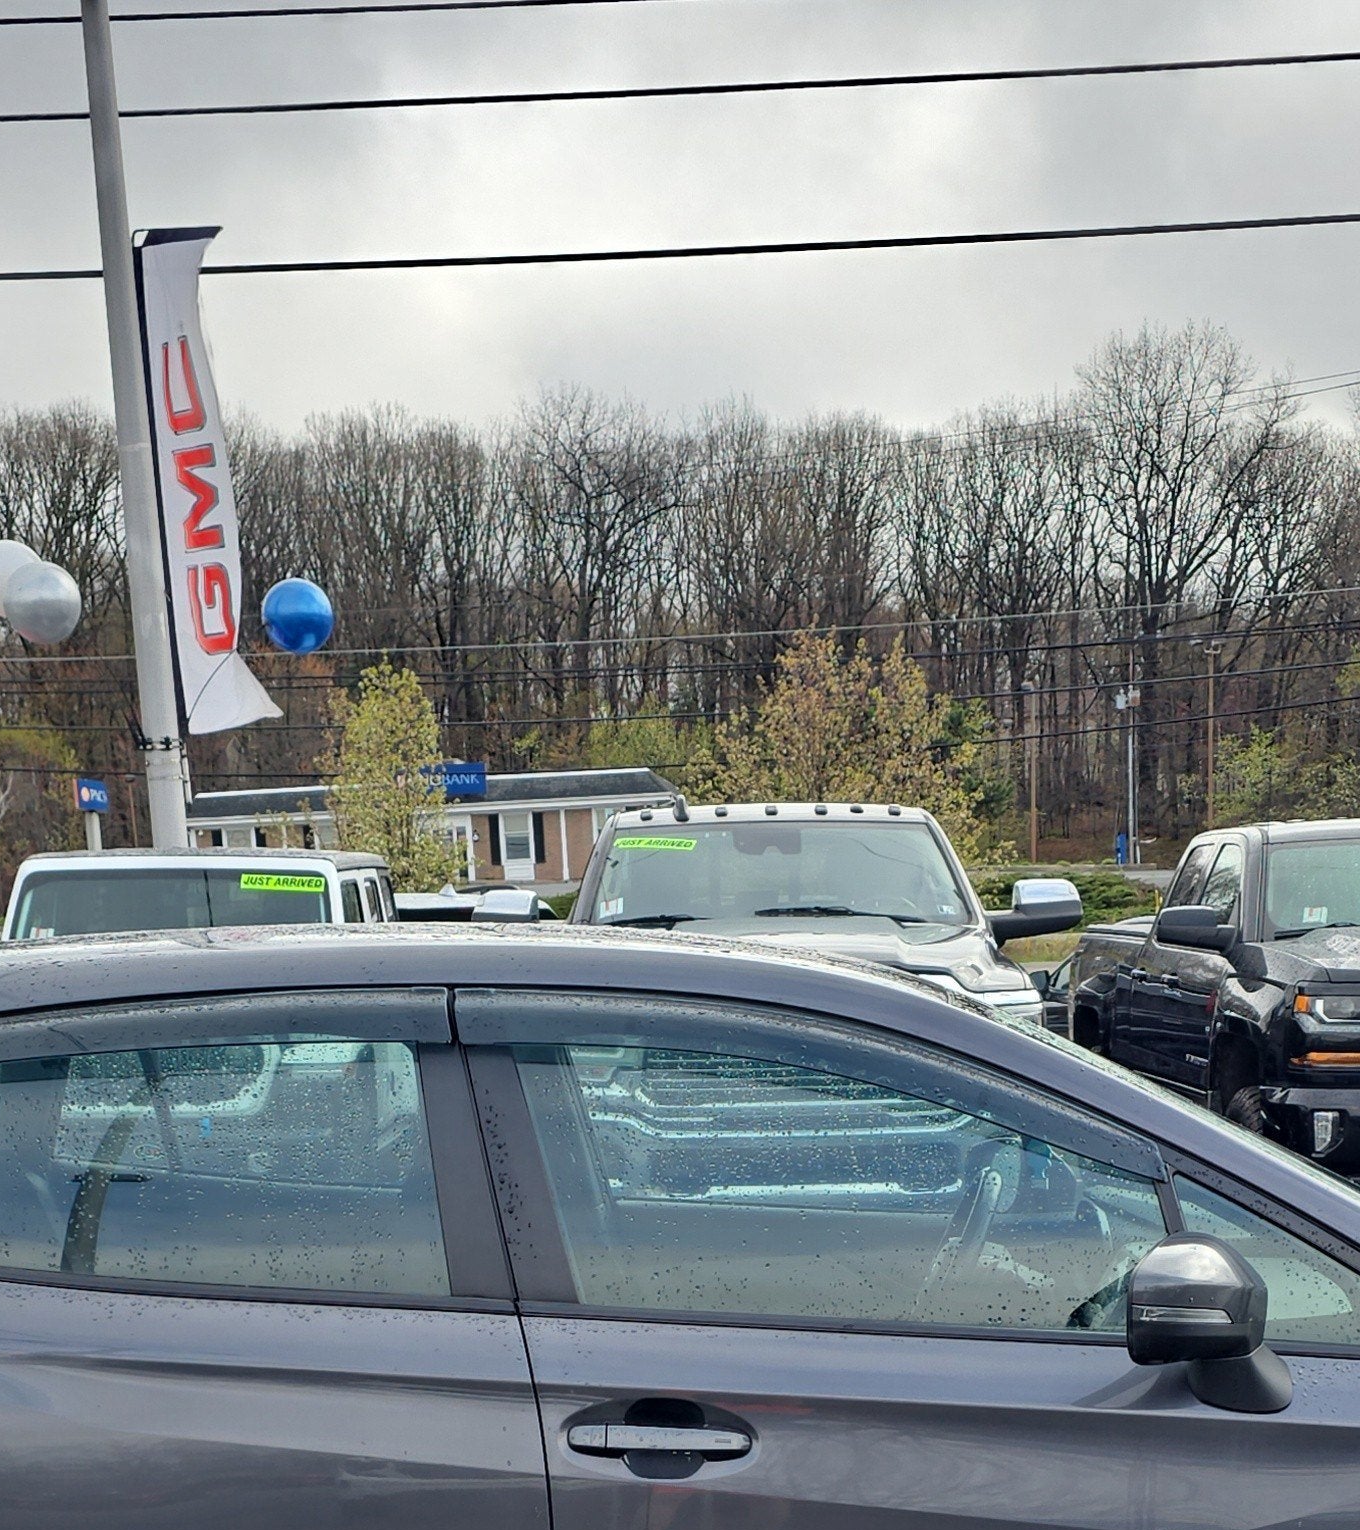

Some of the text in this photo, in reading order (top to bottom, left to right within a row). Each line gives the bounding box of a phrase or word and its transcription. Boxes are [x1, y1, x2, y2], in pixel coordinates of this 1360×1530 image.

[162, 335, 236, 655] GMC
[442, 773, 480, 786] BANK
[616, 839, 693, 848] JUST ARRIVED
[243, 876, 323, 888] JUST ARRIVED
